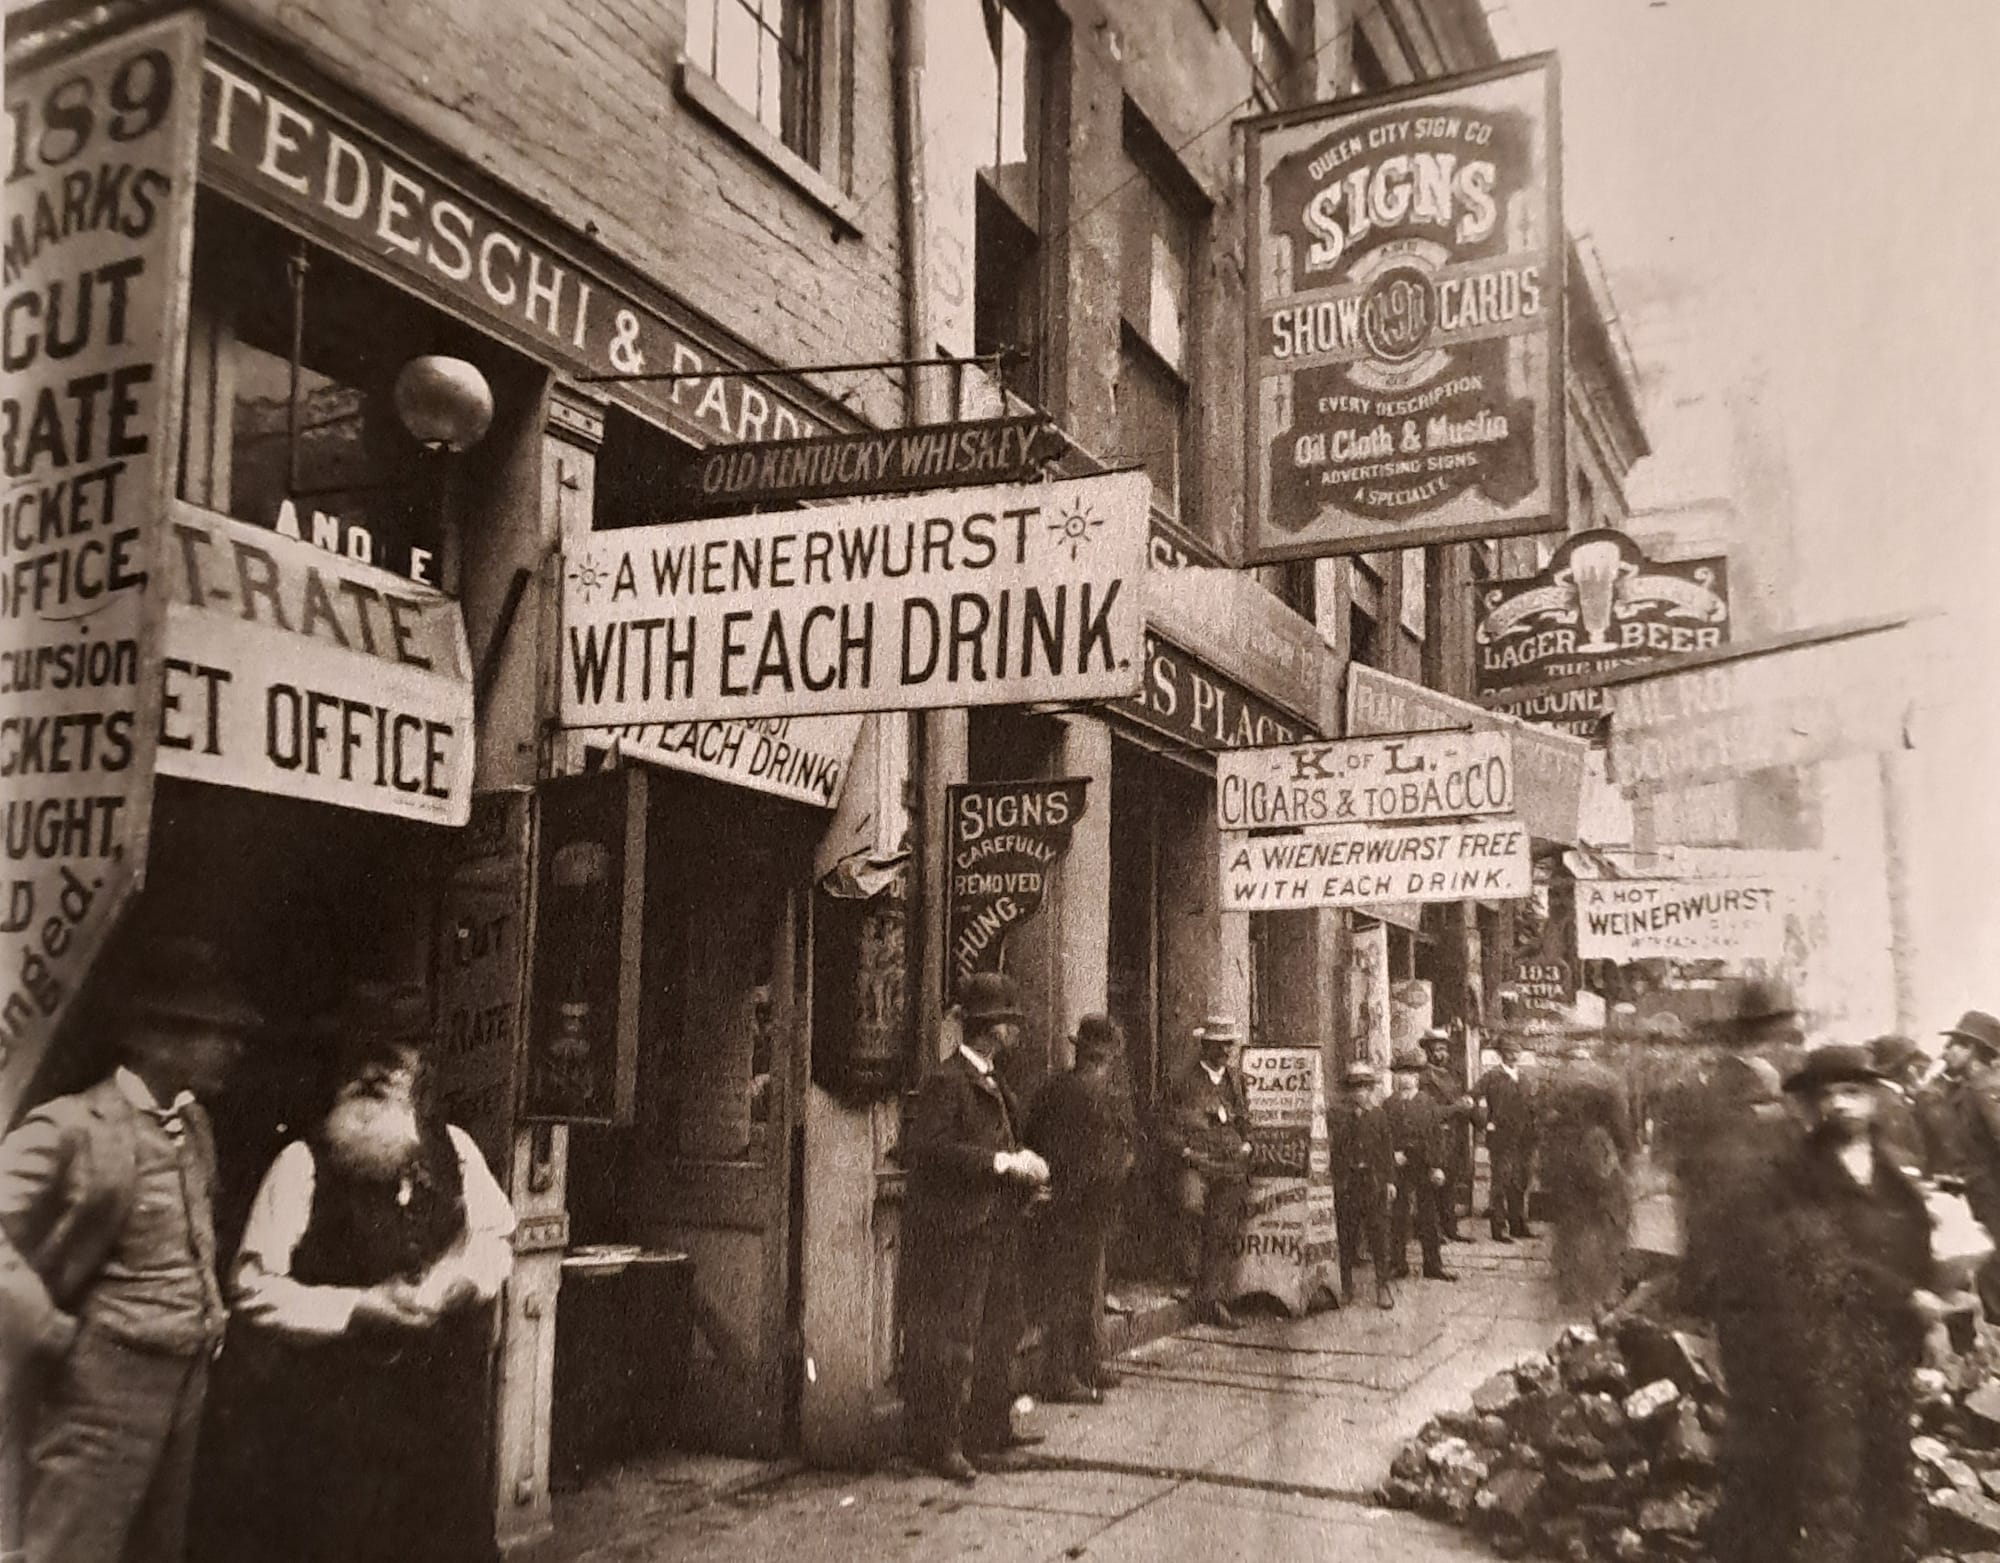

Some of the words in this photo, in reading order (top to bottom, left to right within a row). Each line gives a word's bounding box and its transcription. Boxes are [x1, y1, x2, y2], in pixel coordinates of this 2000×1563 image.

[1308, 138, 1363, 181] QUEEN
[1369, 120, 1410, 149] CITY
[1414, 116, 1460, 140] SIGN
[203, 58, 593, 350] TEDESCHI
[608, 310, 645, 374] &
[1302, 150, 1498, 274] SIGNS
[3, 257, 144, 373] CUT
[1272, 297, 1363, 360] SHOW
[1436, 265, 1541, 332] CARDS
[1319, 395, 1371, 415] EVERY
[1376, 374, 1484, 418] DESCRIPTION
[1331, 424, 1394, 464] Cloth
[1401, 419, 1422, 453] &
[1427, 409, 1509, 448] Muslin
[703, 450, 756, 493] OLD
[759, 438, 897, 489] KENTUCKY
[1321, 459, 1421, 486] ADVERTISING
[1354, 487, 1366, 502] A
[1367, 476, 1448, 507] SPECIALTY
[611, 551, 637, 601] A
[652, 507, 1041, 596] WIENERWURST
[570, 617, 695, 705] WITH
[721, 601, 875, 697] EACH
[902, 578, 1132, 687] DRINK.
[1484, 629, 1577, 671] LAGER
[1620, 621, 1722, 652] BEER
[266, 683, 453, 797] OFFICE
[1347, 752, 1375, 771] OF
[1222, 773, 1327, 825] CIGARS
[1337, 788, 1356, 818] &
[1365, 756, 1508, 816] TOBACCO
[960, 791, 1069, 842] SIGNS
[956, 834, 1057, 869] CAREFULLY
[1230, 848, 1251, 872] A
[1264, 835, 1448, 870] WIENERWURST
[1458, 831, 1522, 858] FREE
[955, 872, 1041, 896] REMOVED
[1233, 875, 1308, 902] WITH
[1323, 874, 1393, 898] EACH
[1408, 870, 1513, 896] DRINK.
[1589, 890, 1604, 904] A
[1613, 888, 1659, 904] HOT
[1587, 888, 1775, 937] WEINERWURST
